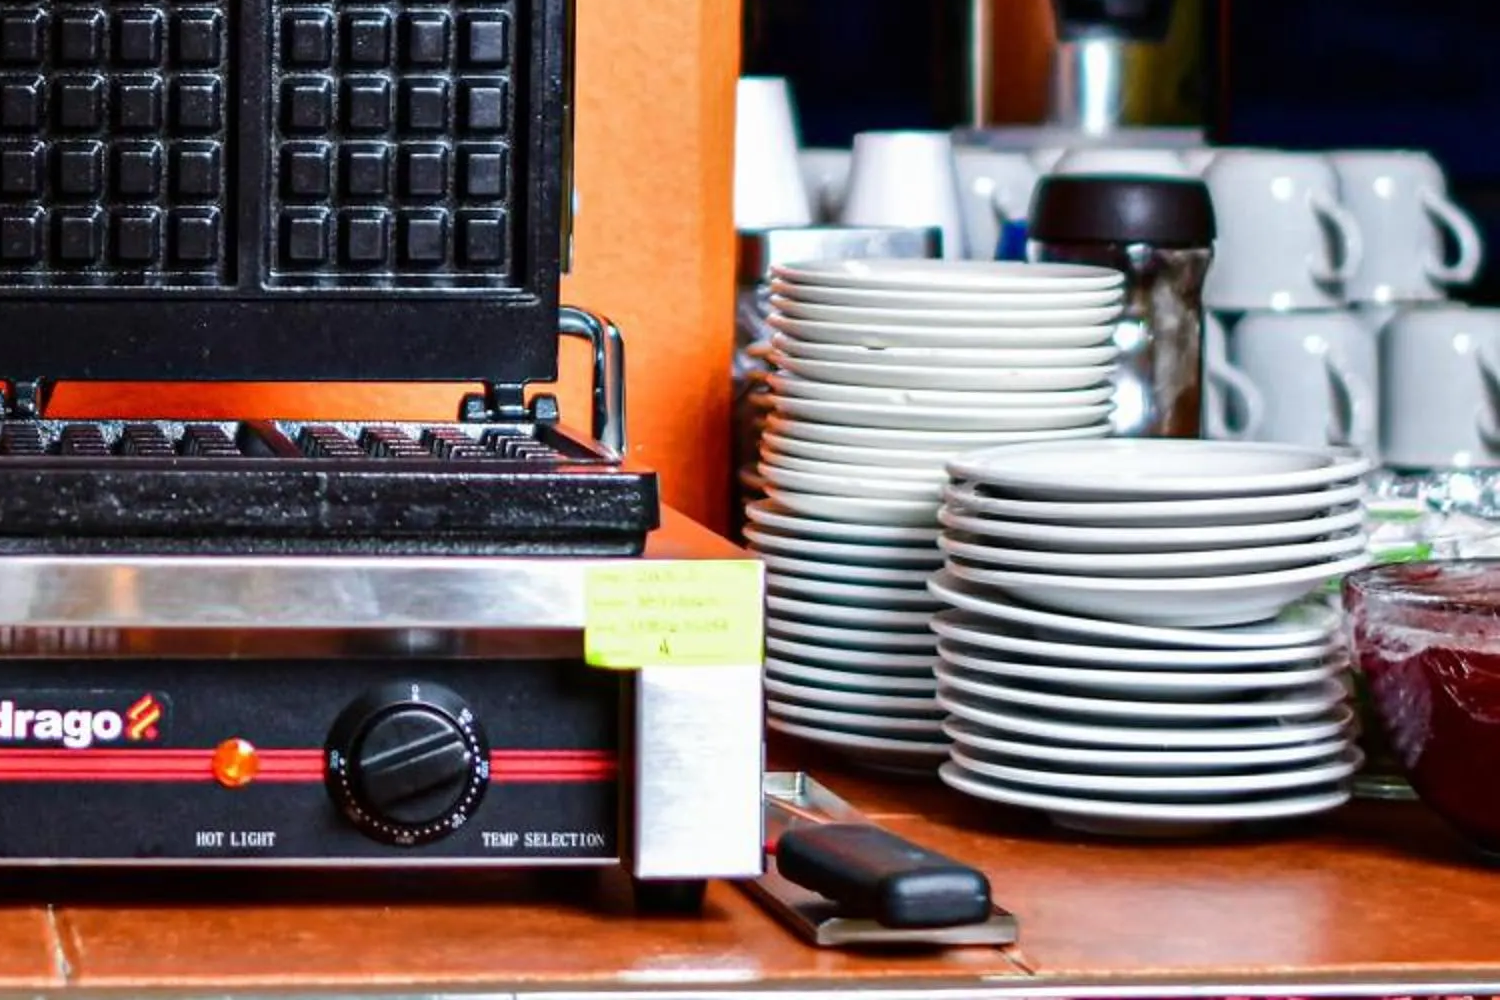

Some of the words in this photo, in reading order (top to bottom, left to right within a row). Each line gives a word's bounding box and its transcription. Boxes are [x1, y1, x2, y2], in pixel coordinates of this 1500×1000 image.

[196, 832, 223, 847] HOT
[231, 832, 276, 847] LIGHT
[481, 832, 518, 847] TEMP
[523, 832, 604, 847] SELECTION
